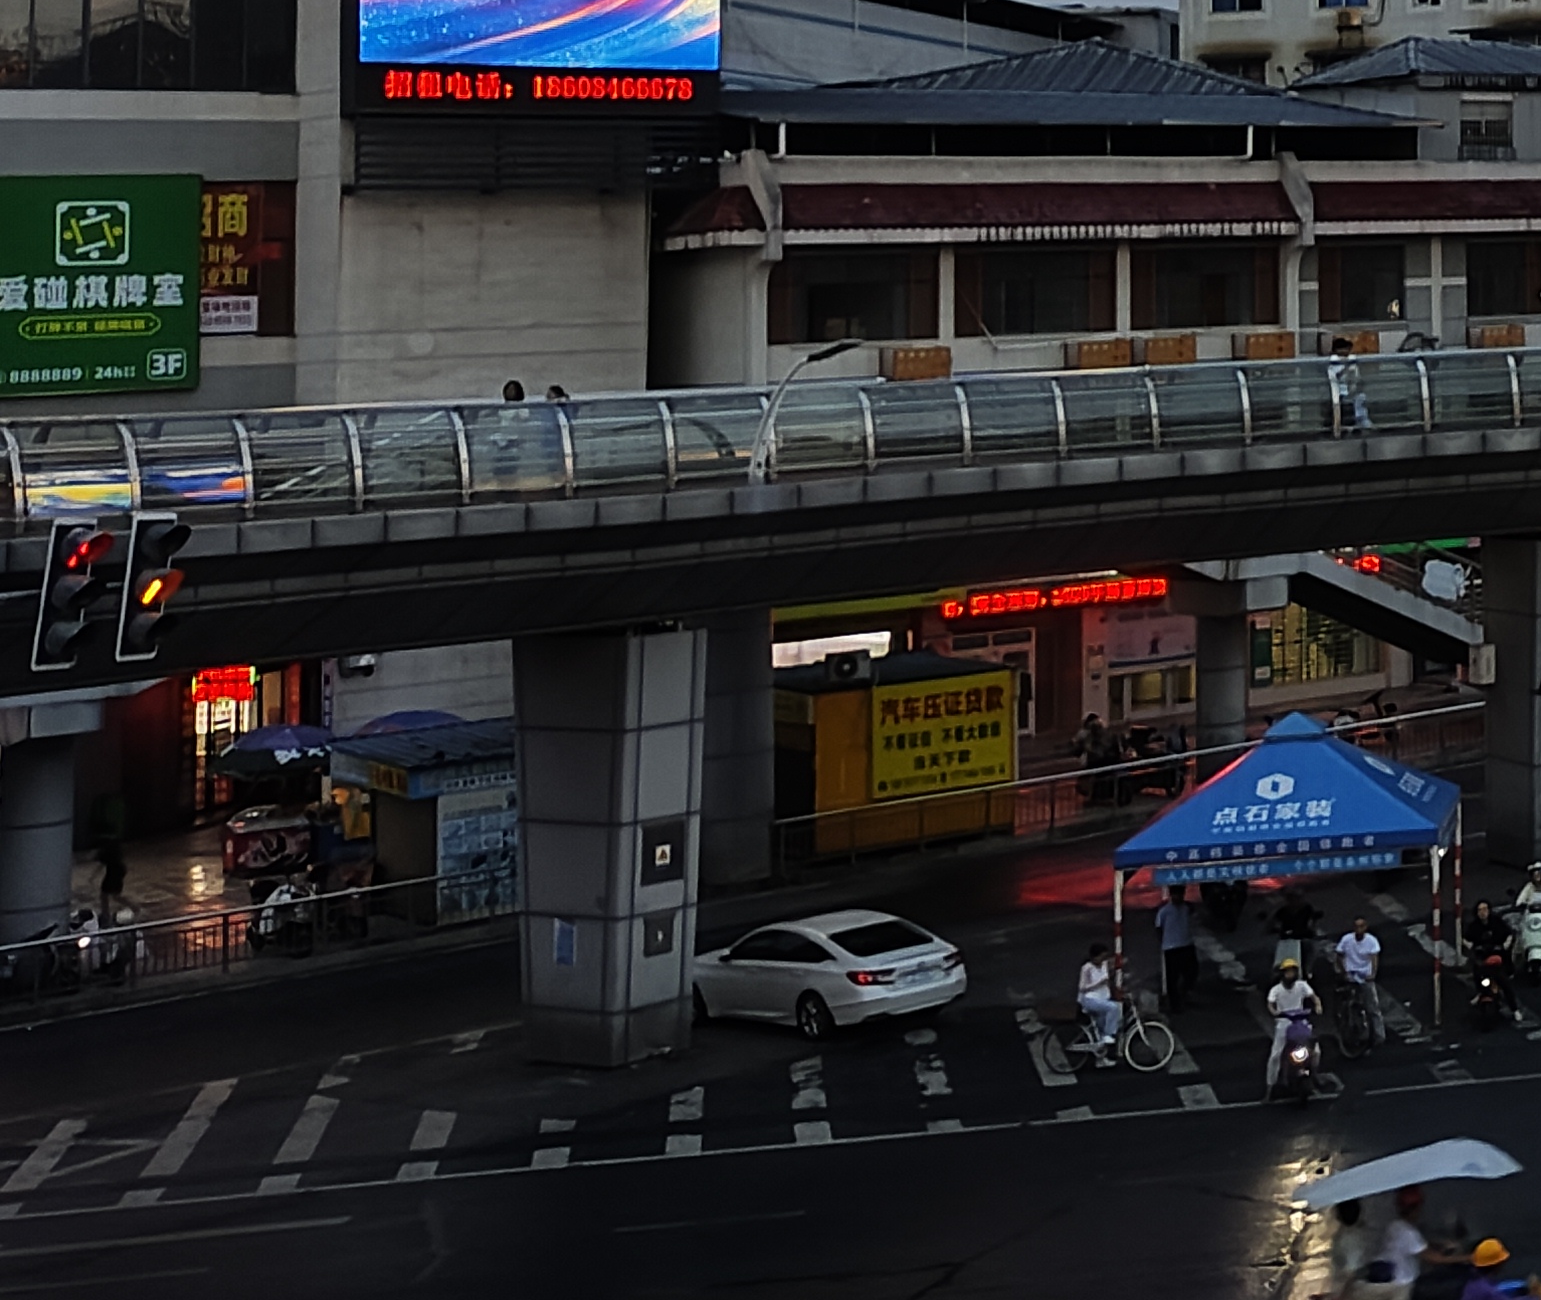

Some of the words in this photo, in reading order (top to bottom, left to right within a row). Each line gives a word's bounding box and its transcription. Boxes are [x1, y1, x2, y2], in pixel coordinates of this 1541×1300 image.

[150, 353, 183, 376] 3F
[1211, 798, 1334, 826] 点石家装
